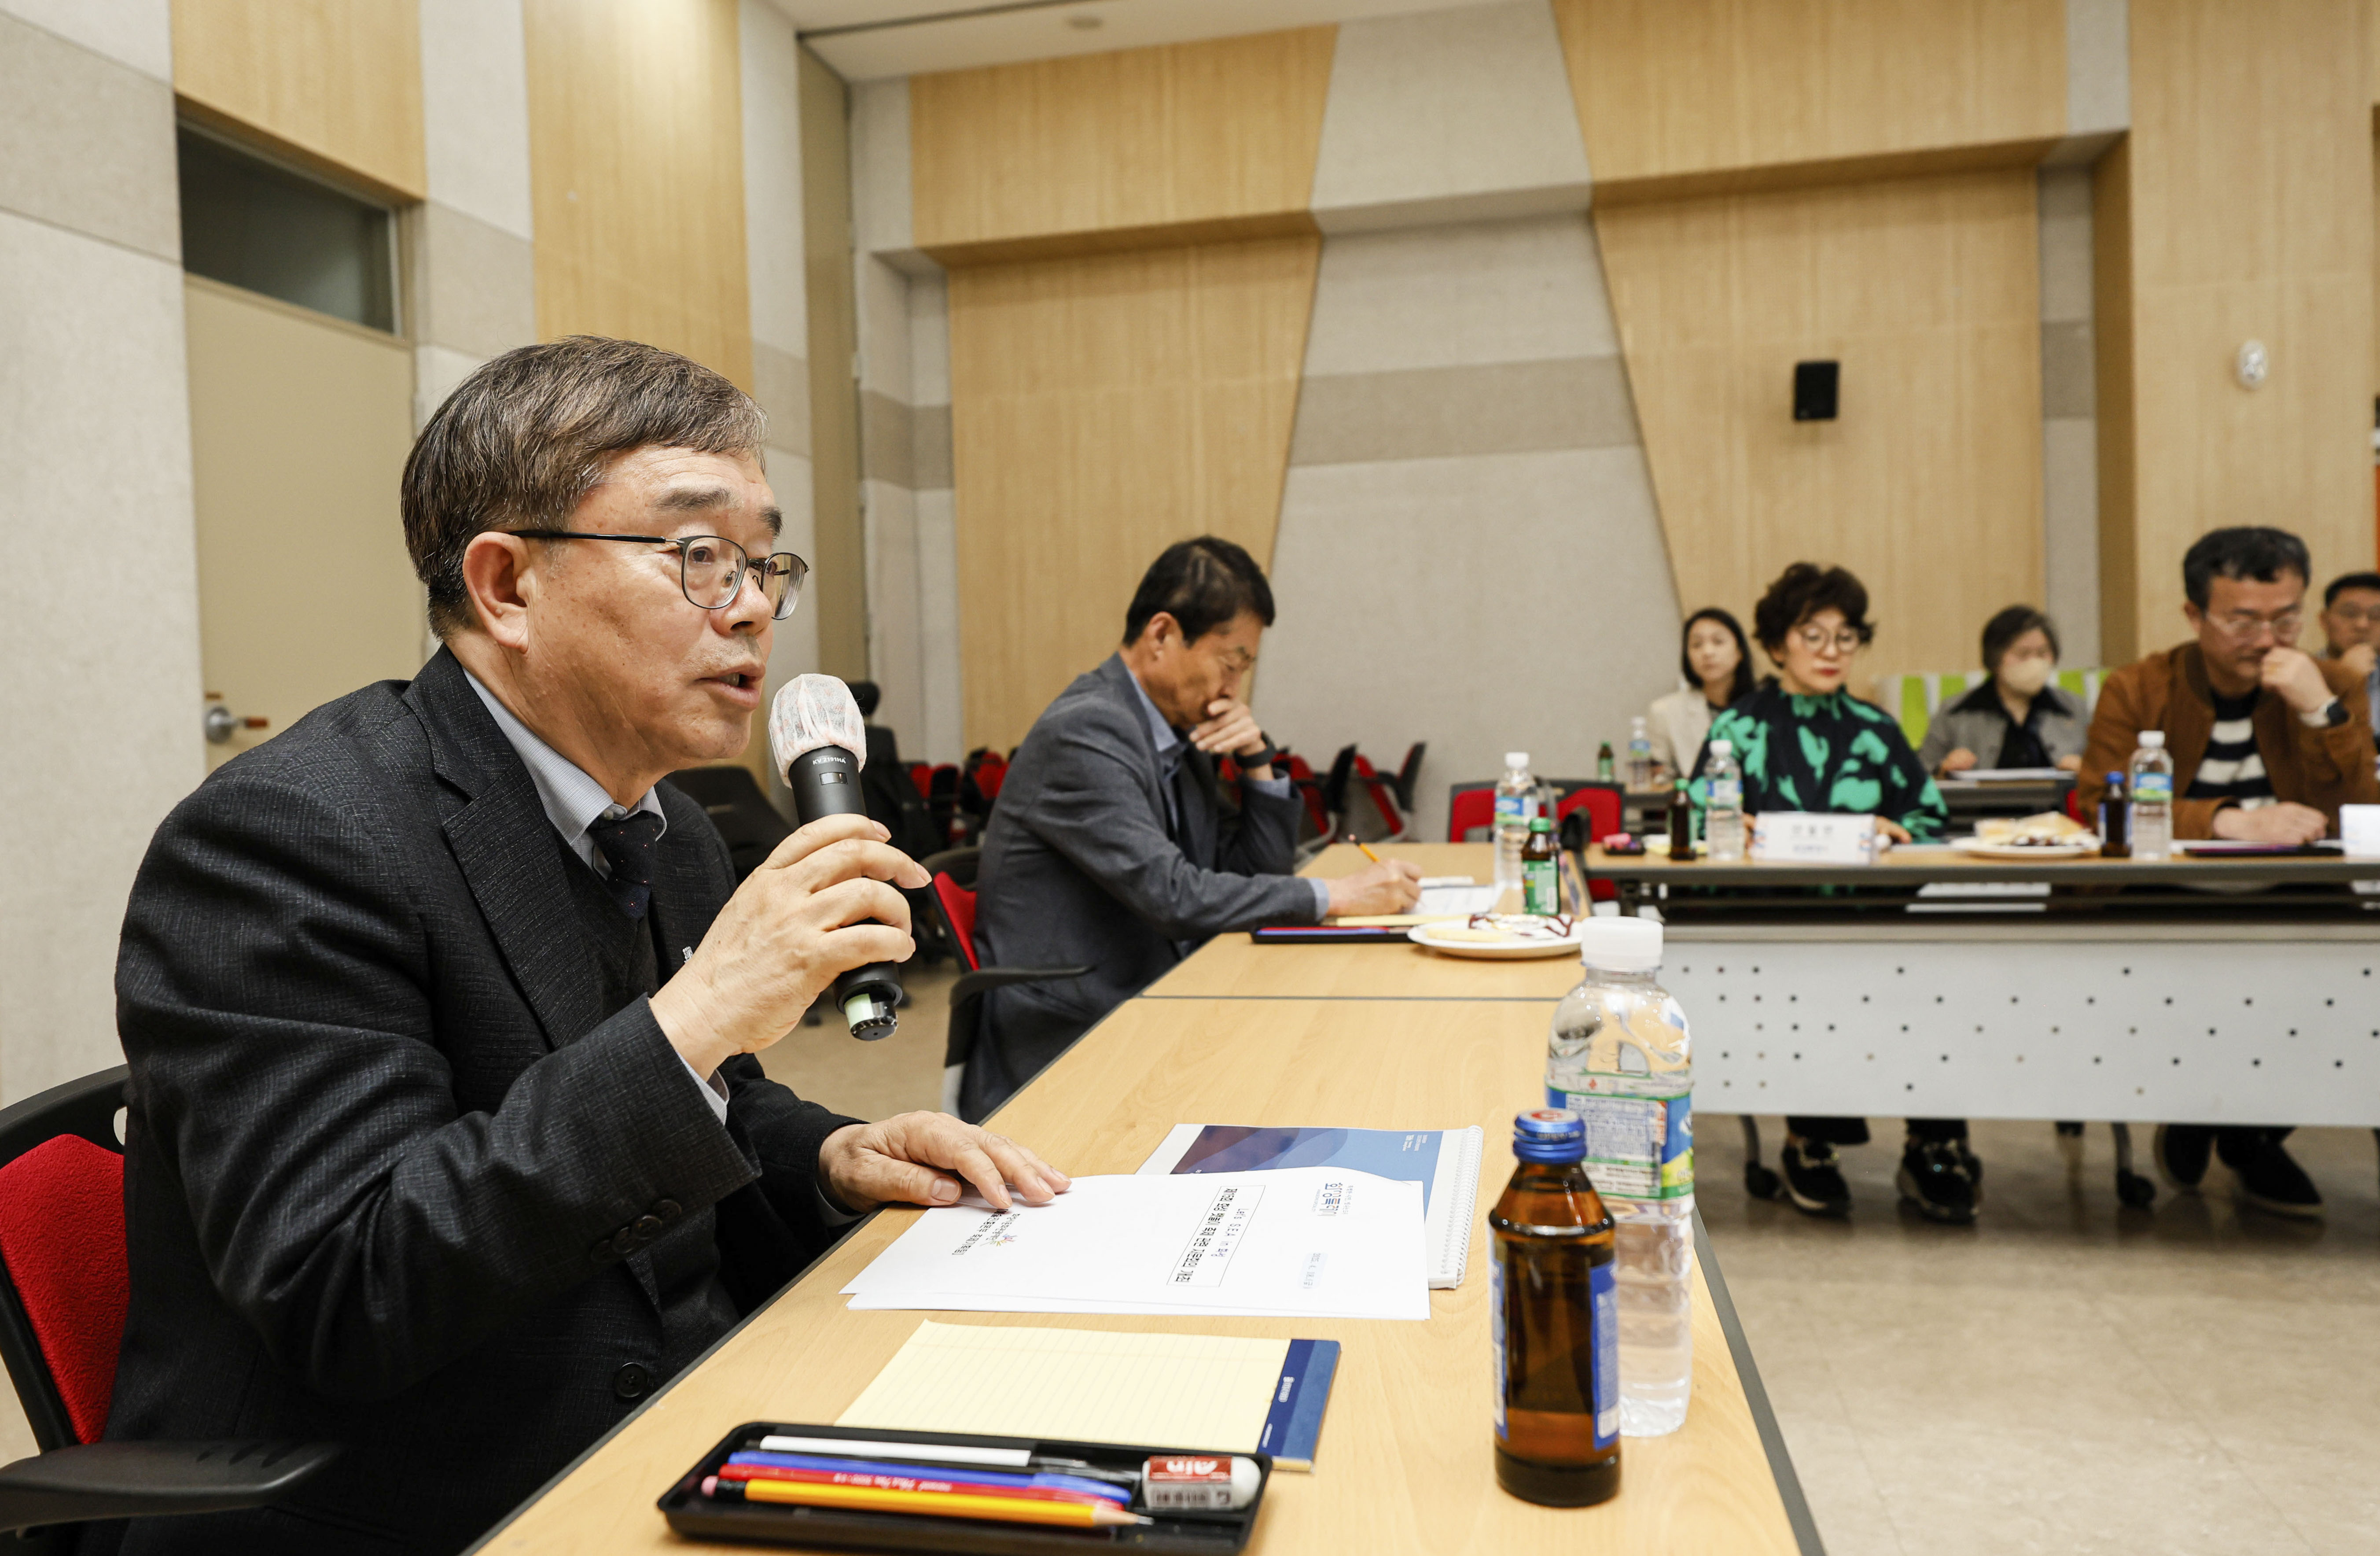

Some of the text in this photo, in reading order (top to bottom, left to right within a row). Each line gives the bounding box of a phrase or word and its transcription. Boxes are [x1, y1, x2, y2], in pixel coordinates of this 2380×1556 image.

[1214, 1203, 1230, 1212] 화성
[1205, 1213, 1225, 1226] 뱃놀이
[1199, 1228, 1217, 1236] 축제
[1193, 1238, 1211, 1246] 관련
